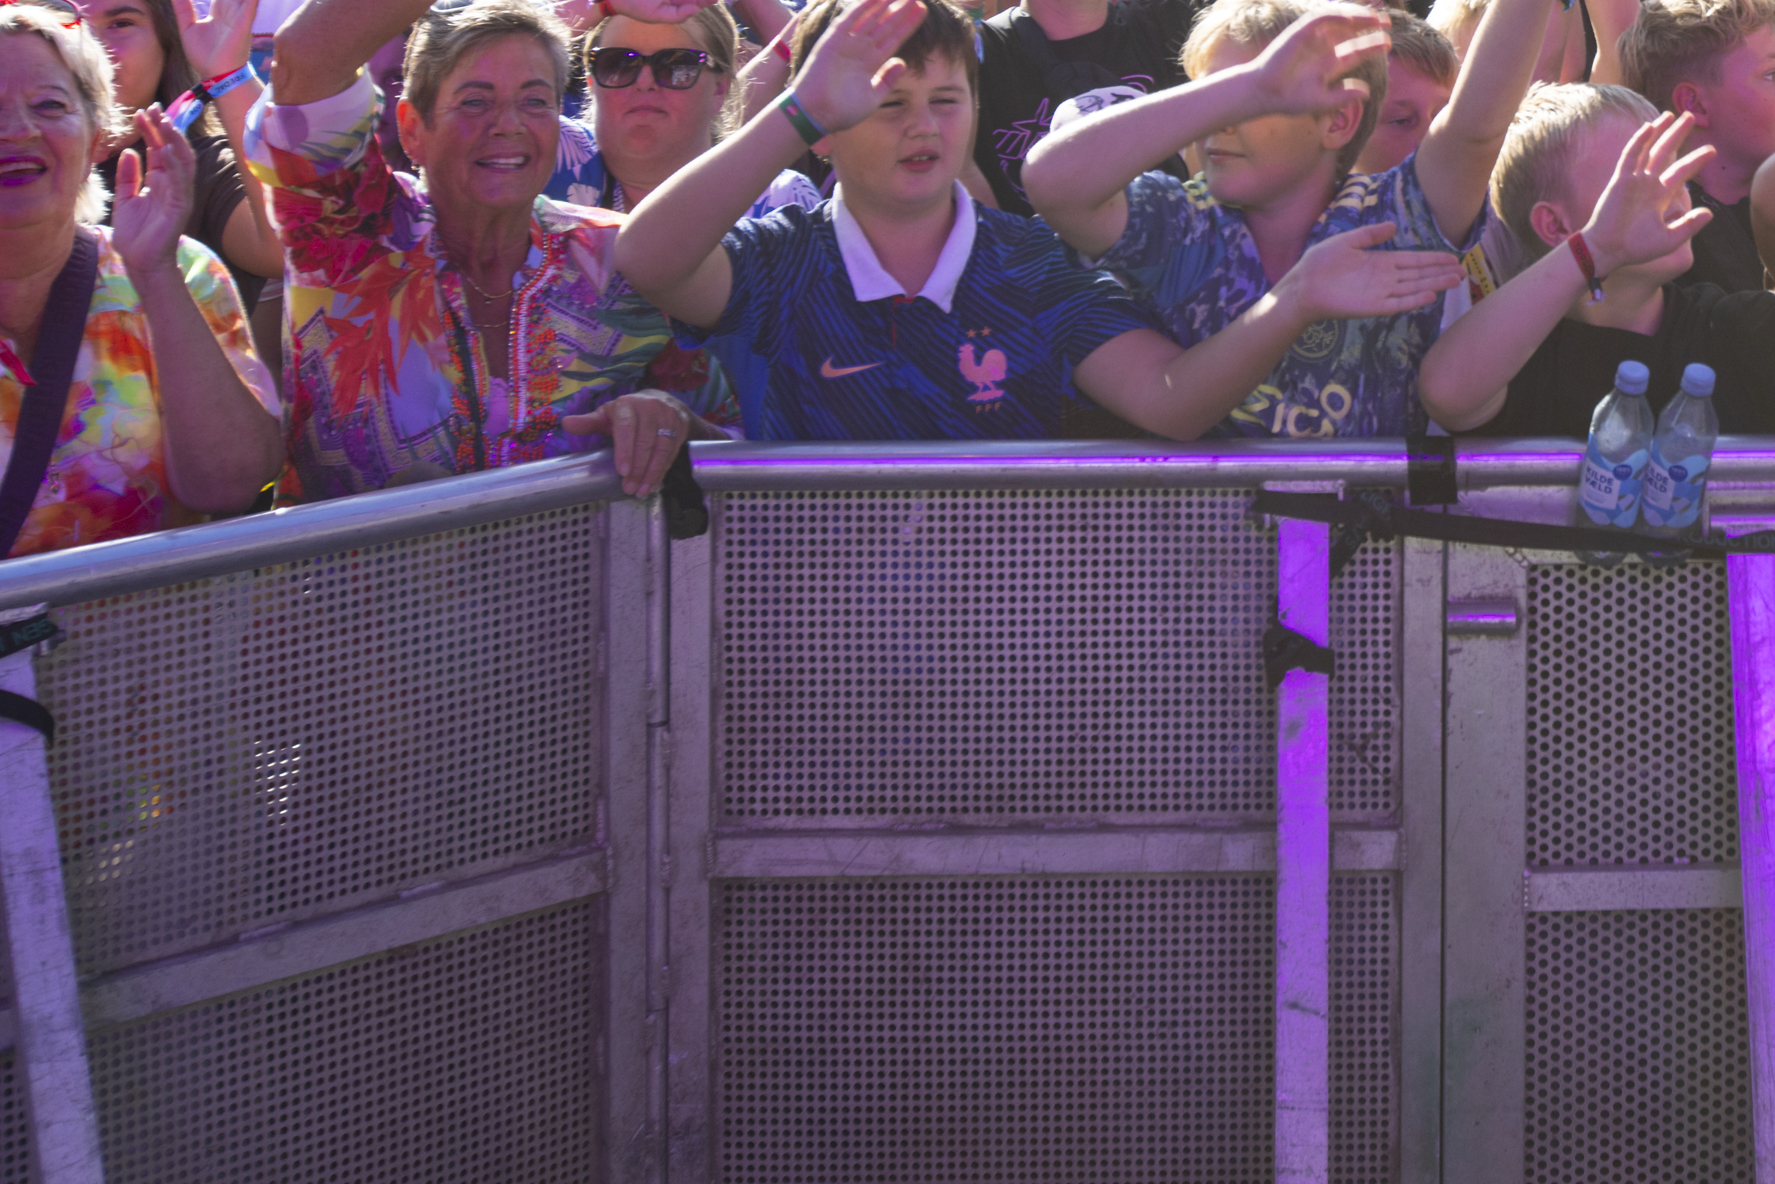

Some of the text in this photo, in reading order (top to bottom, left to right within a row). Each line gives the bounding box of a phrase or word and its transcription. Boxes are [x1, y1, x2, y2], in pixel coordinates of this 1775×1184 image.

[975, 401, 1001, 414] FFF
[1585, 474, 1612, 494] VÆLD
[1586, 465, 1614, 486] KILDE
[1646, 476, 1667, 494] ÆLD
